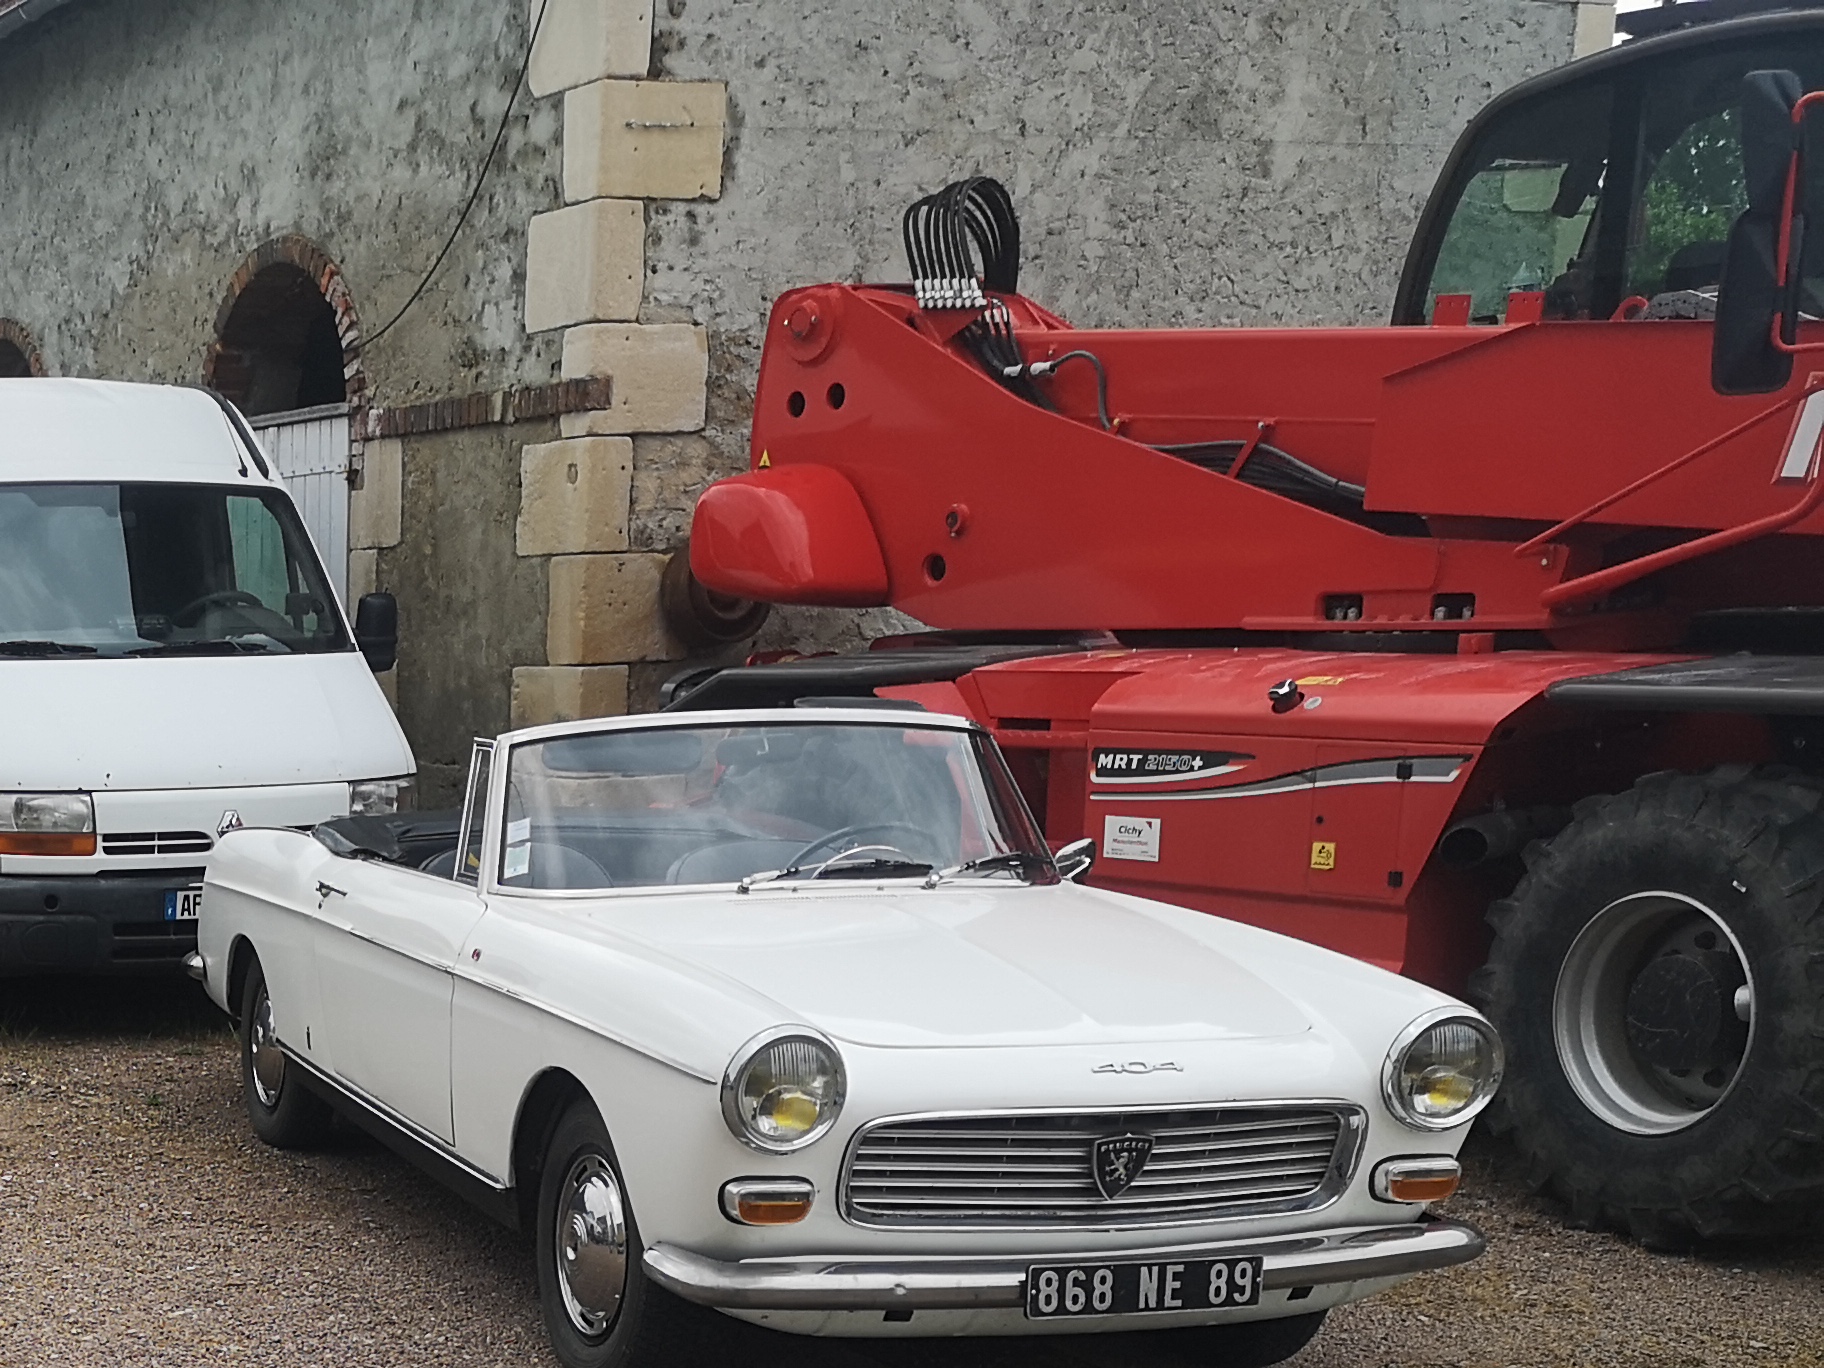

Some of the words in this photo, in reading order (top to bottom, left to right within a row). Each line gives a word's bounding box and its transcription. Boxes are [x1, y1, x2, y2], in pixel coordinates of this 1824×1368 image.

[1097, 753, 1143, 769] MRT
[1118, 825, 1144, 838] Cichy
[1100, 1141, 1150, 1153] PEUGEOT
[1038, 1268, 1113, 1313] 868
[1138, 1264, 1185, 1309] NE
[1208, 1261, 1254, 1305] 89
